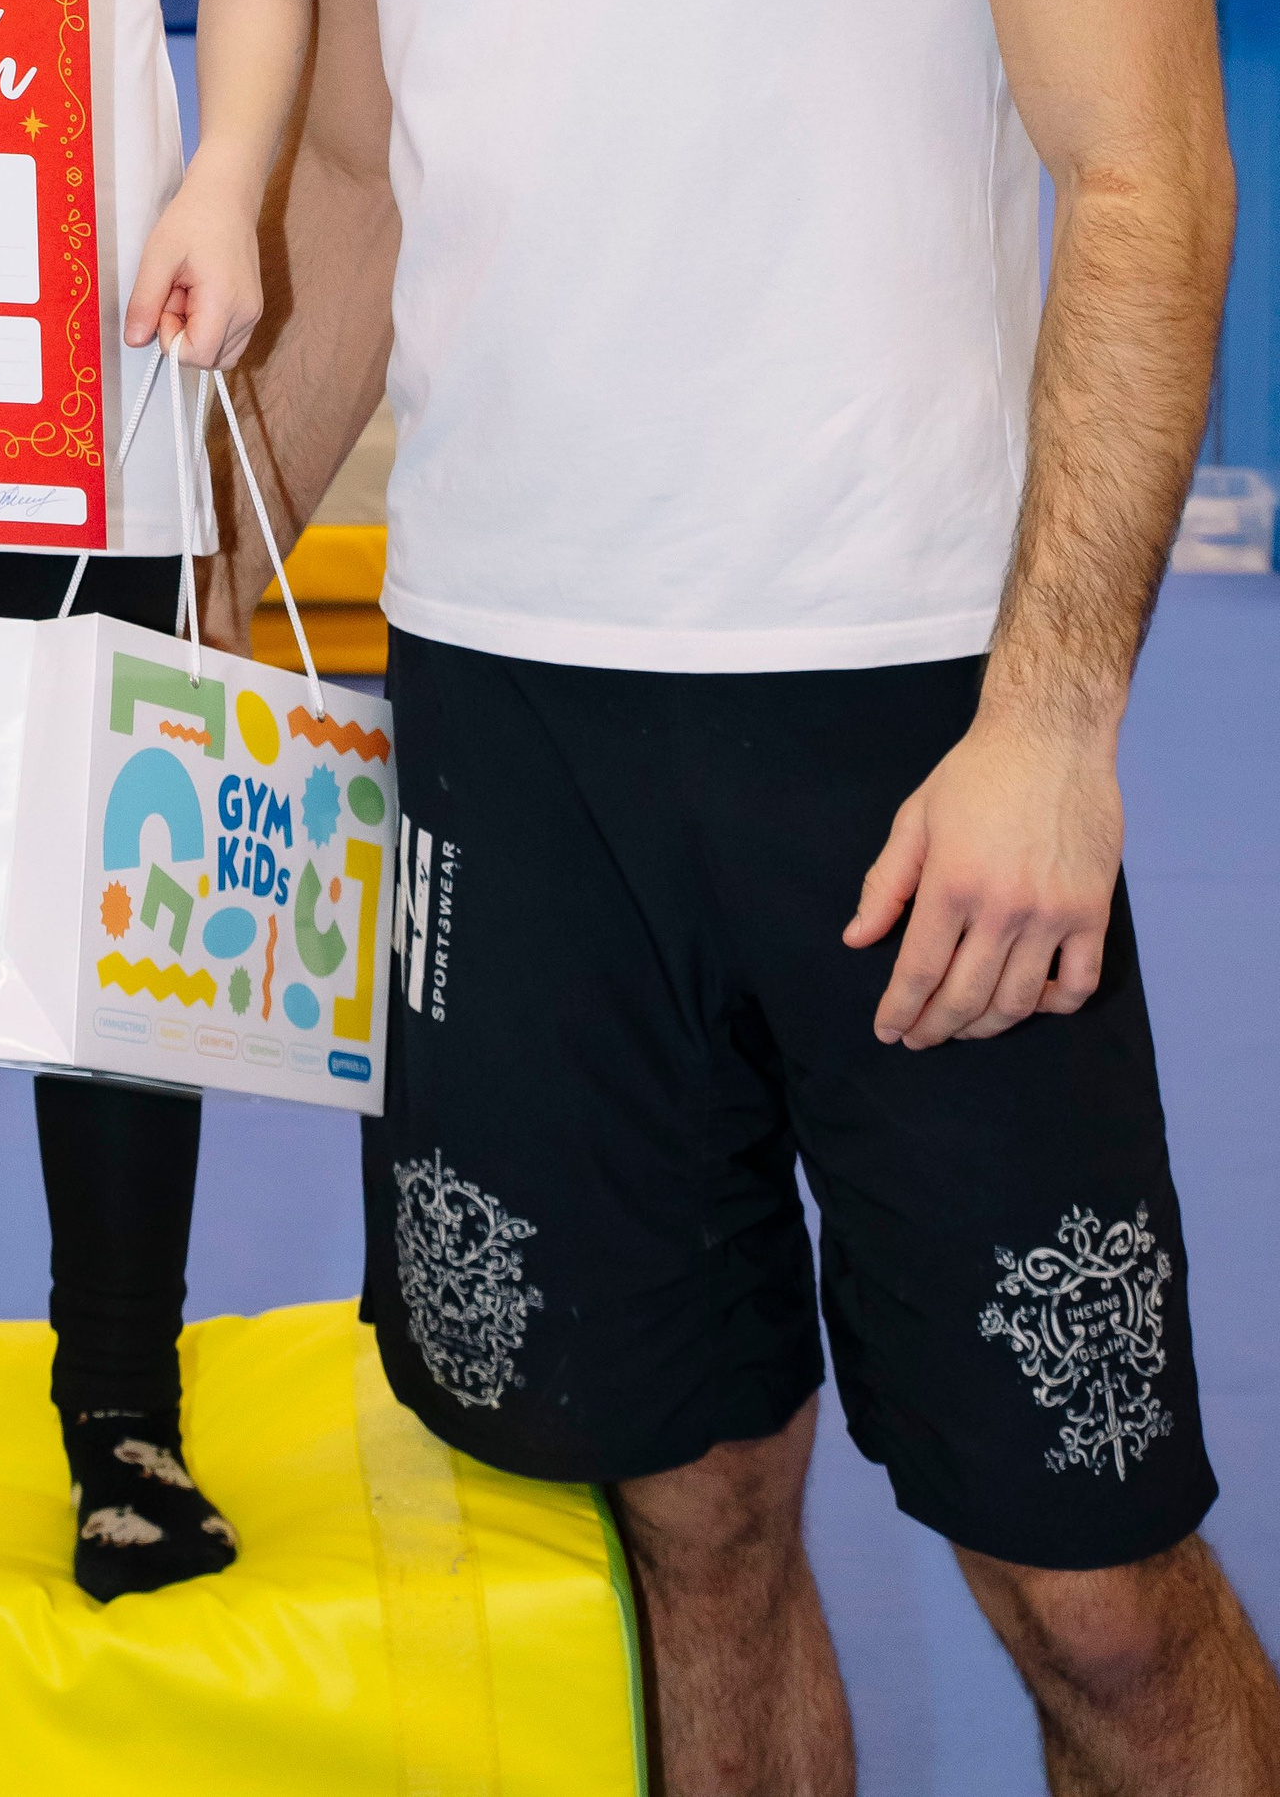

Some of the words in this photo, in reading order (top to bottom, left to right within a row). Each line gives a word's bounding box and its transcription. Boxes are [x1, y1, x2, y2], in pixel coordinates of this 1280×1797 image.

[218, 773, 294, 851] GYM
[431, 840, 456, 1023] SPORTSWEAR
[1088, 1320, 1106, 1338] OF
